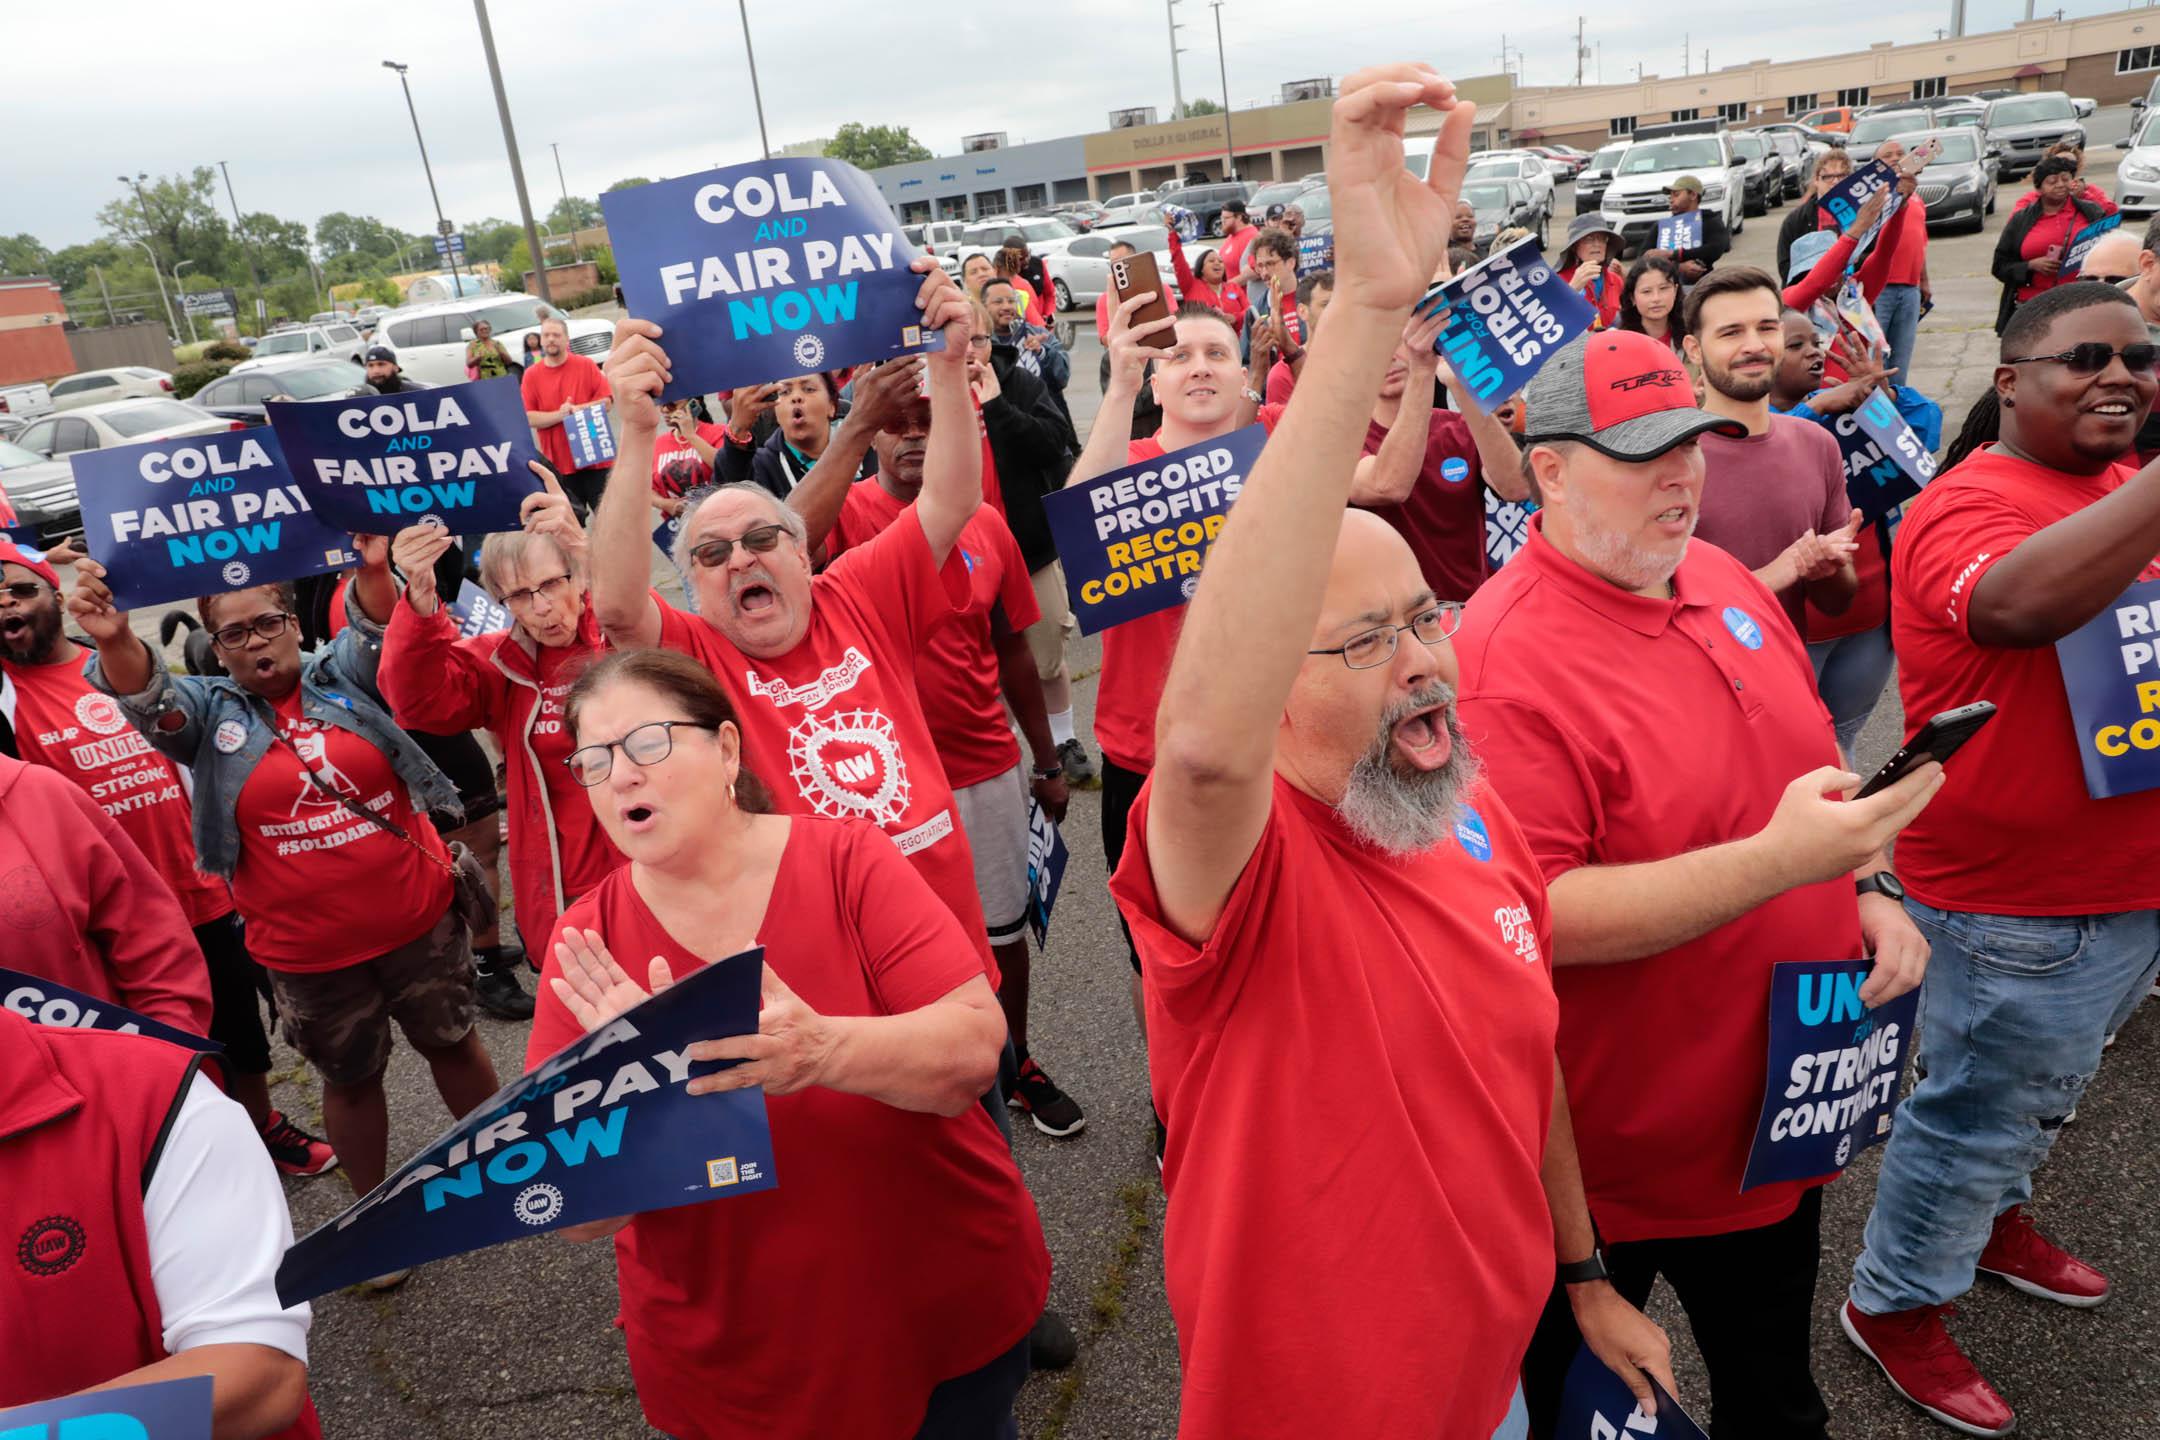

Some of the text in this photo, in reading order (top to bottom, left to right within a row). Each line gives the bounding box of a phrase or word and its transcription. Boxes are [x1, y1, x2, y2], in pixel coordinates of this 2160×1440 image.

[694, 170, 846, 224] COLA
[753, 217, 807, 243] AND
[660, 232, 895, 305] FAIR PAY
[728, 281, 858, 340] NOW
[1466, 311, 1490, 339] FOR
[338, 397, 471, 439] COLA
[139, 440, 272, 484] COLA
[313, 441, 514, 486] FAIR PAY
[385, 435, 432, 454] AND
[189, 476, 236, 498] AND
[365, 480, 476, 515] NOW
[1089, 448, 1234, 514] RECORD
[110, 485, 312, 543] FAIR PAY
[1094, 474, 1246, 542] PROFITS
[167, 520, 282, 567] NOW
[1106, 511, 1232, 569] RECOR
[1080, 544, 1215, 605] CONTR
[1951, 553, 1991, 594] WILL
[70, 731, 156, 771] UNITE
[110, 759, 148, 775] FOR A
[834, 750, 876, 784] AW
[100, 784, 181, 818] ONTRACT
[259, 819, 309, 838] BETTER
[308, 814, 332, 832] GET
[1797, 971, 1868, 1027] UN
[1784, 1022, 1900, 1099] STRONG
[553, 1042, 704, 1124] PAY
[1770, 1070, 1897, 1142] CONTRACT
[421, 1106, 629, 1213] NOW
[740, 1161, 757, 1171] JOIN
[741, 1168, 755, 1177] THE
[741, 1172, 763, 1183] FIGHT
[527, 1195, 549, 1213] UAW
[35, 1234, 67, 1258] UAW
